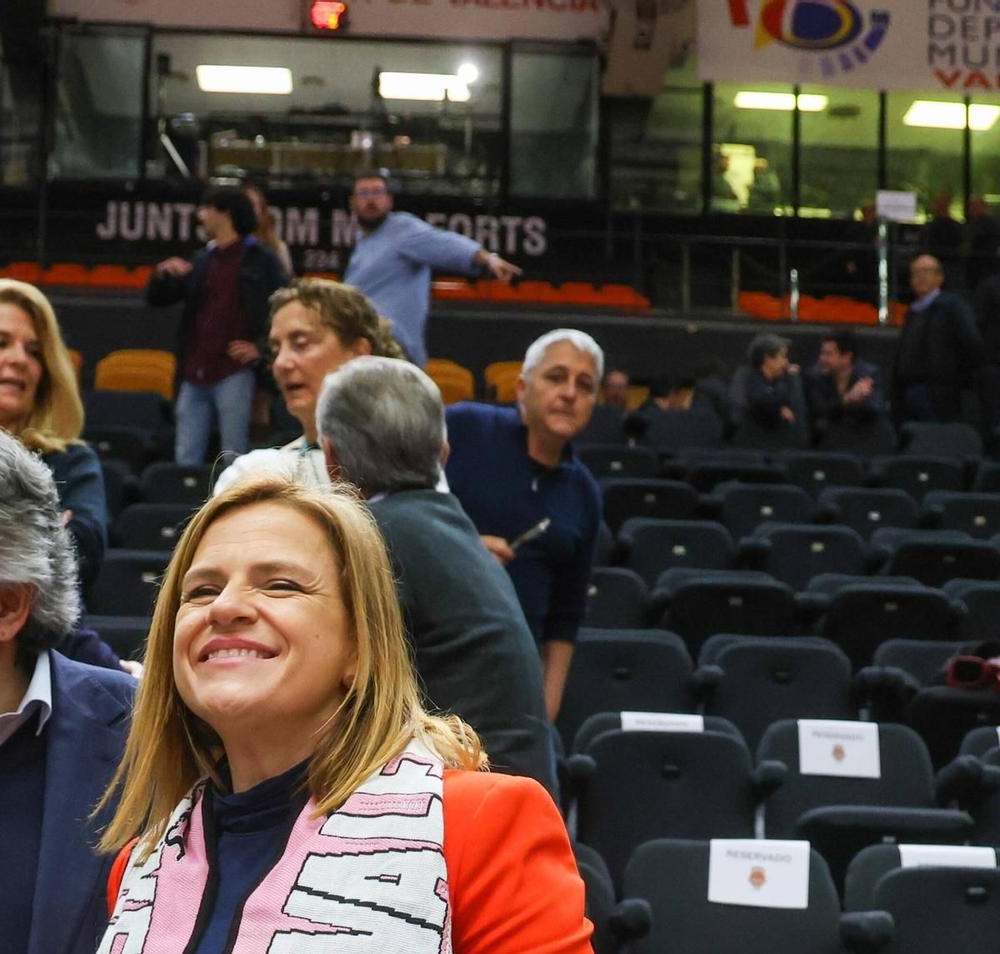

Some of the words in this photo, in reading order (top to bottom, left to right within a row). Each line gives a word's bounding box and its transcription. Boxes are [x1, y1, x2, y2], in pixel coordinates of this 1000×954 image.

[928, 44, 1000, 69] MU
[933, 68, 1000, 91] VA
[96, 201, 207, 241] JUNT
